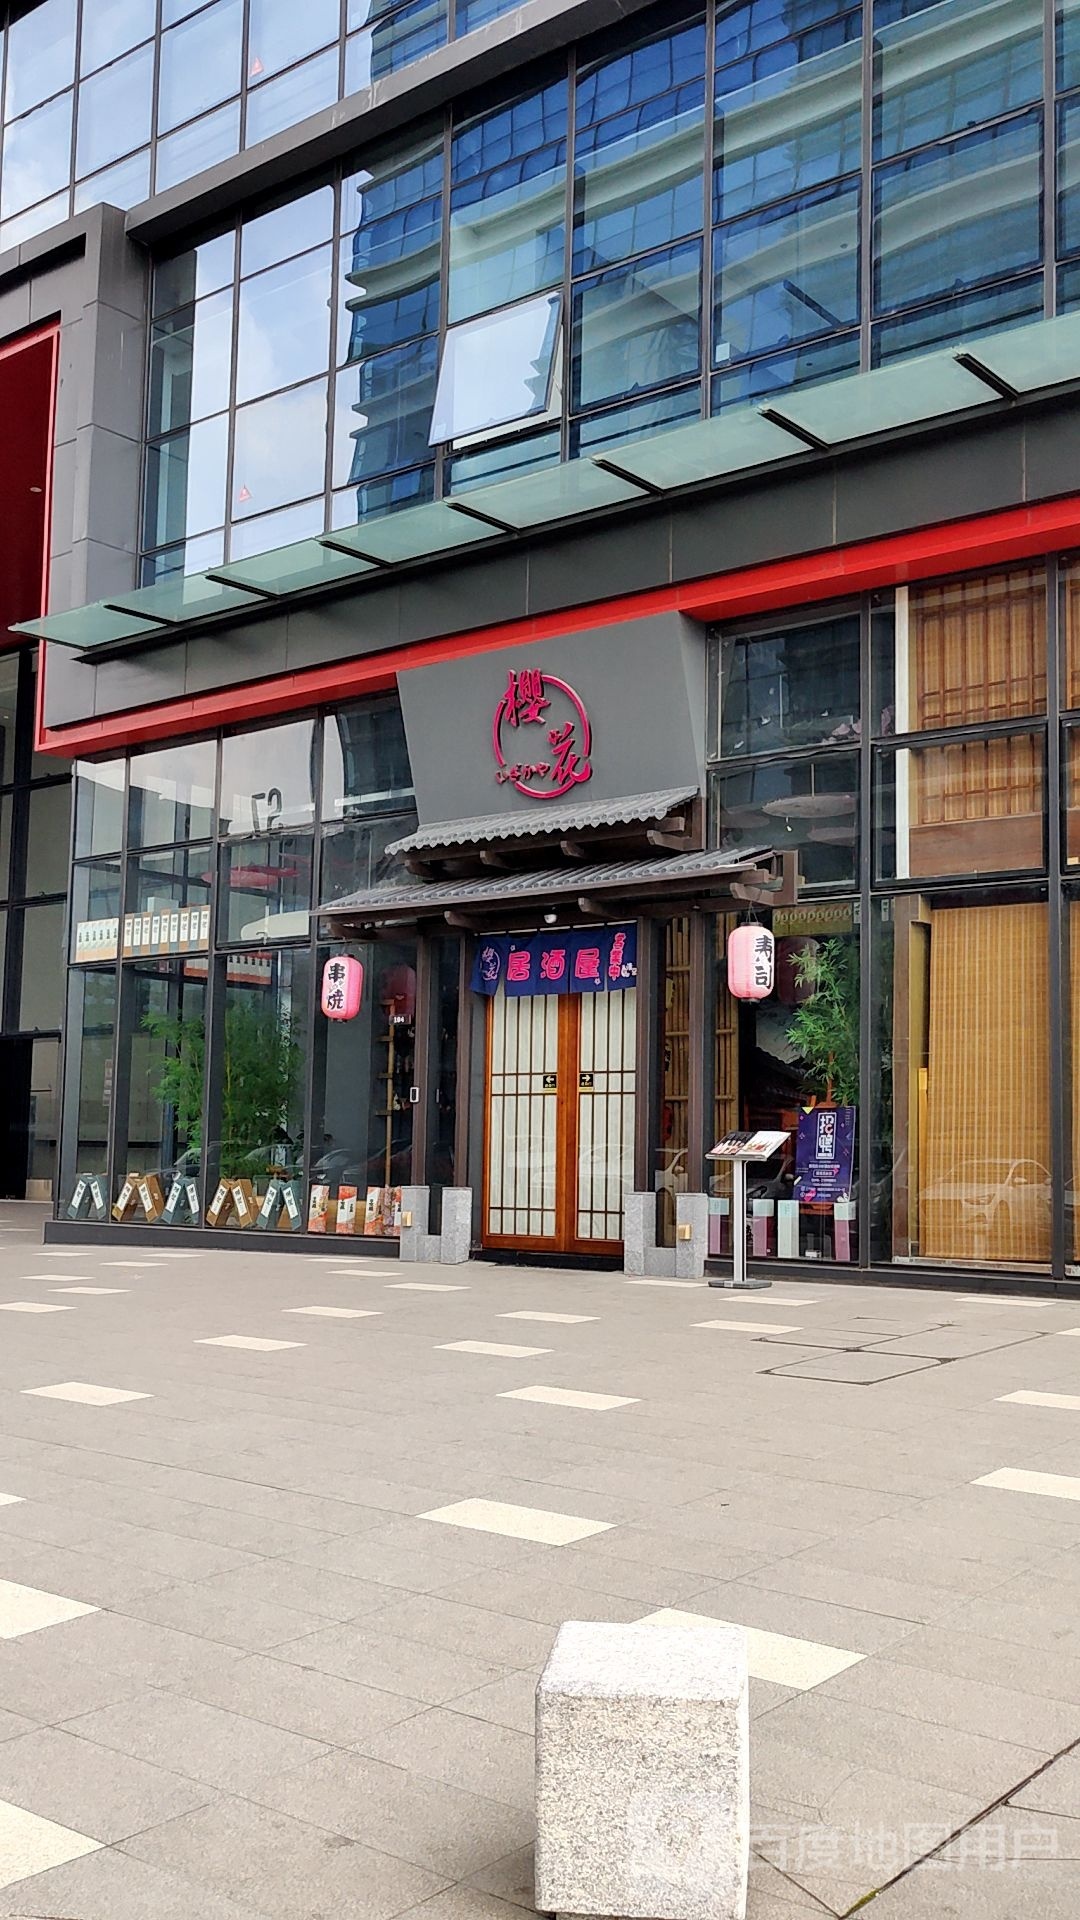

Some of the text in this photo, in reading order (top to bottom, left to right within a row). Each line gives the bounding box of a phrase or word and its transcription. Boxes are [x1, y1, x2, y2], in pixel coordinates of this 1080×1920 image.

[506, 947, 601, 982] 居酒屋
[754, 934, 773, 990] 寿司
